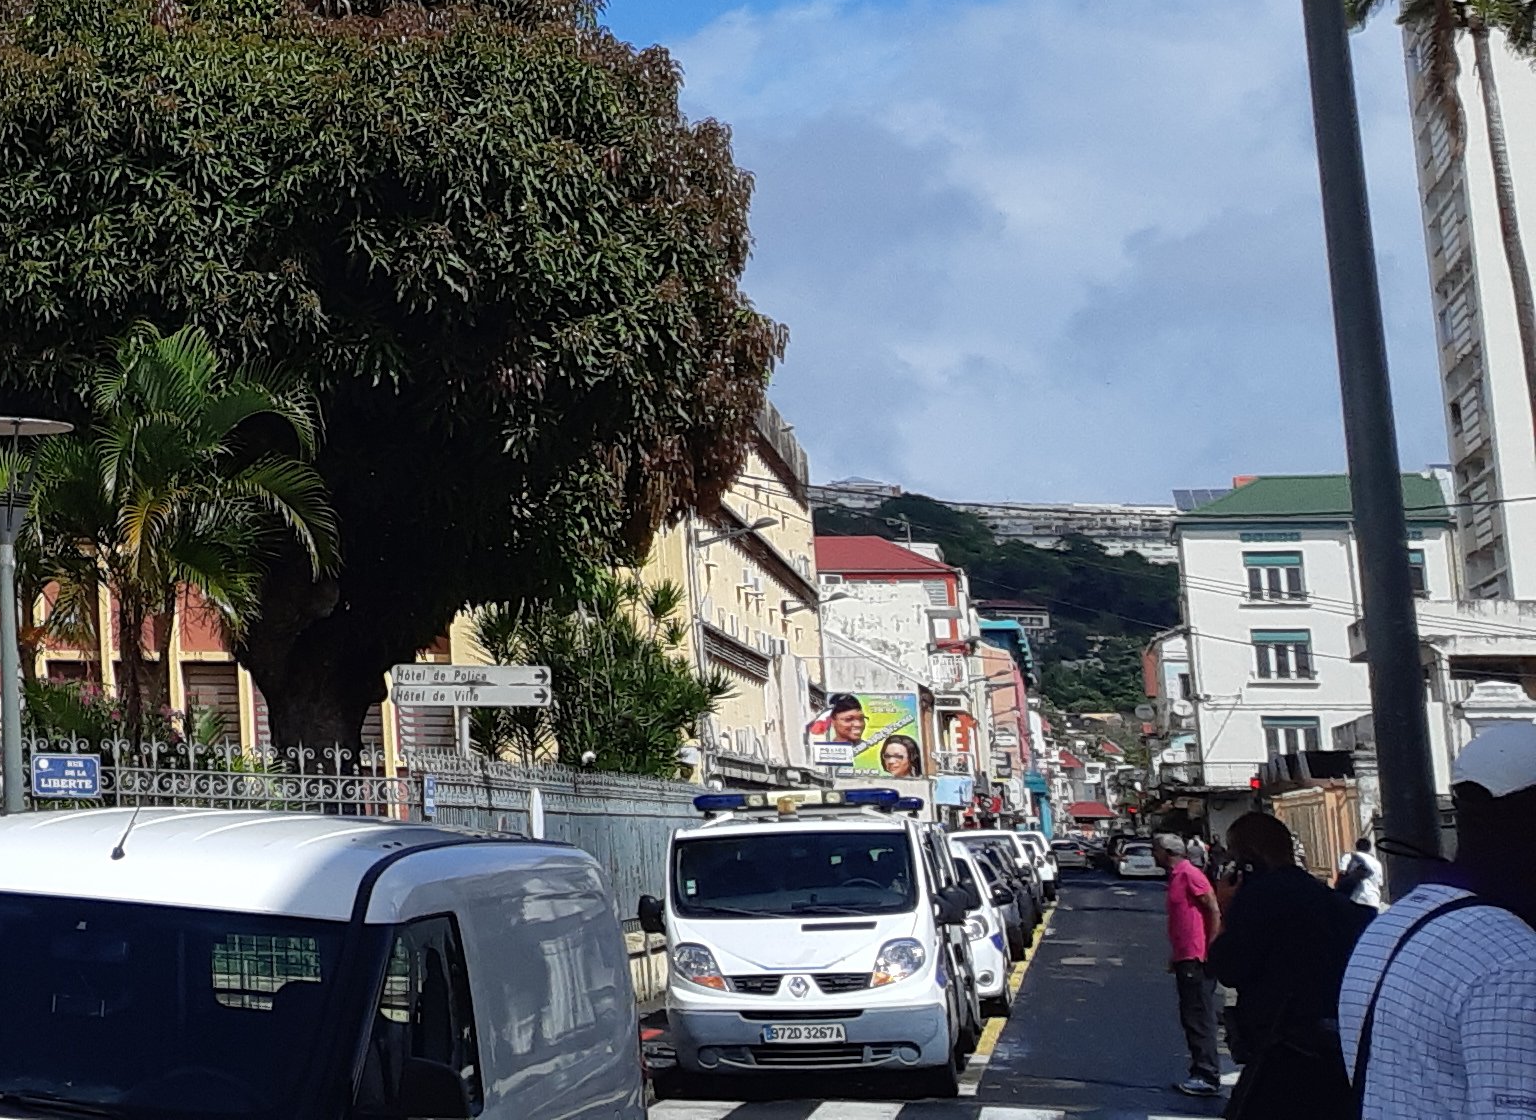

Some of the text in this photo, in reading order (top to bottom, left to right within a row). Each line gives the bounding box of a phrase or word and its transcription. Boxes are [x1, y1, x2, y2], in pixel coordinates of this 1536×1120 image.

[433, 669, 446, 682] de
[454, 669, 488, 682] Police
[395, 689, 480, 702] Hôtel de Ville
[77, 769, 87, 777] LA
